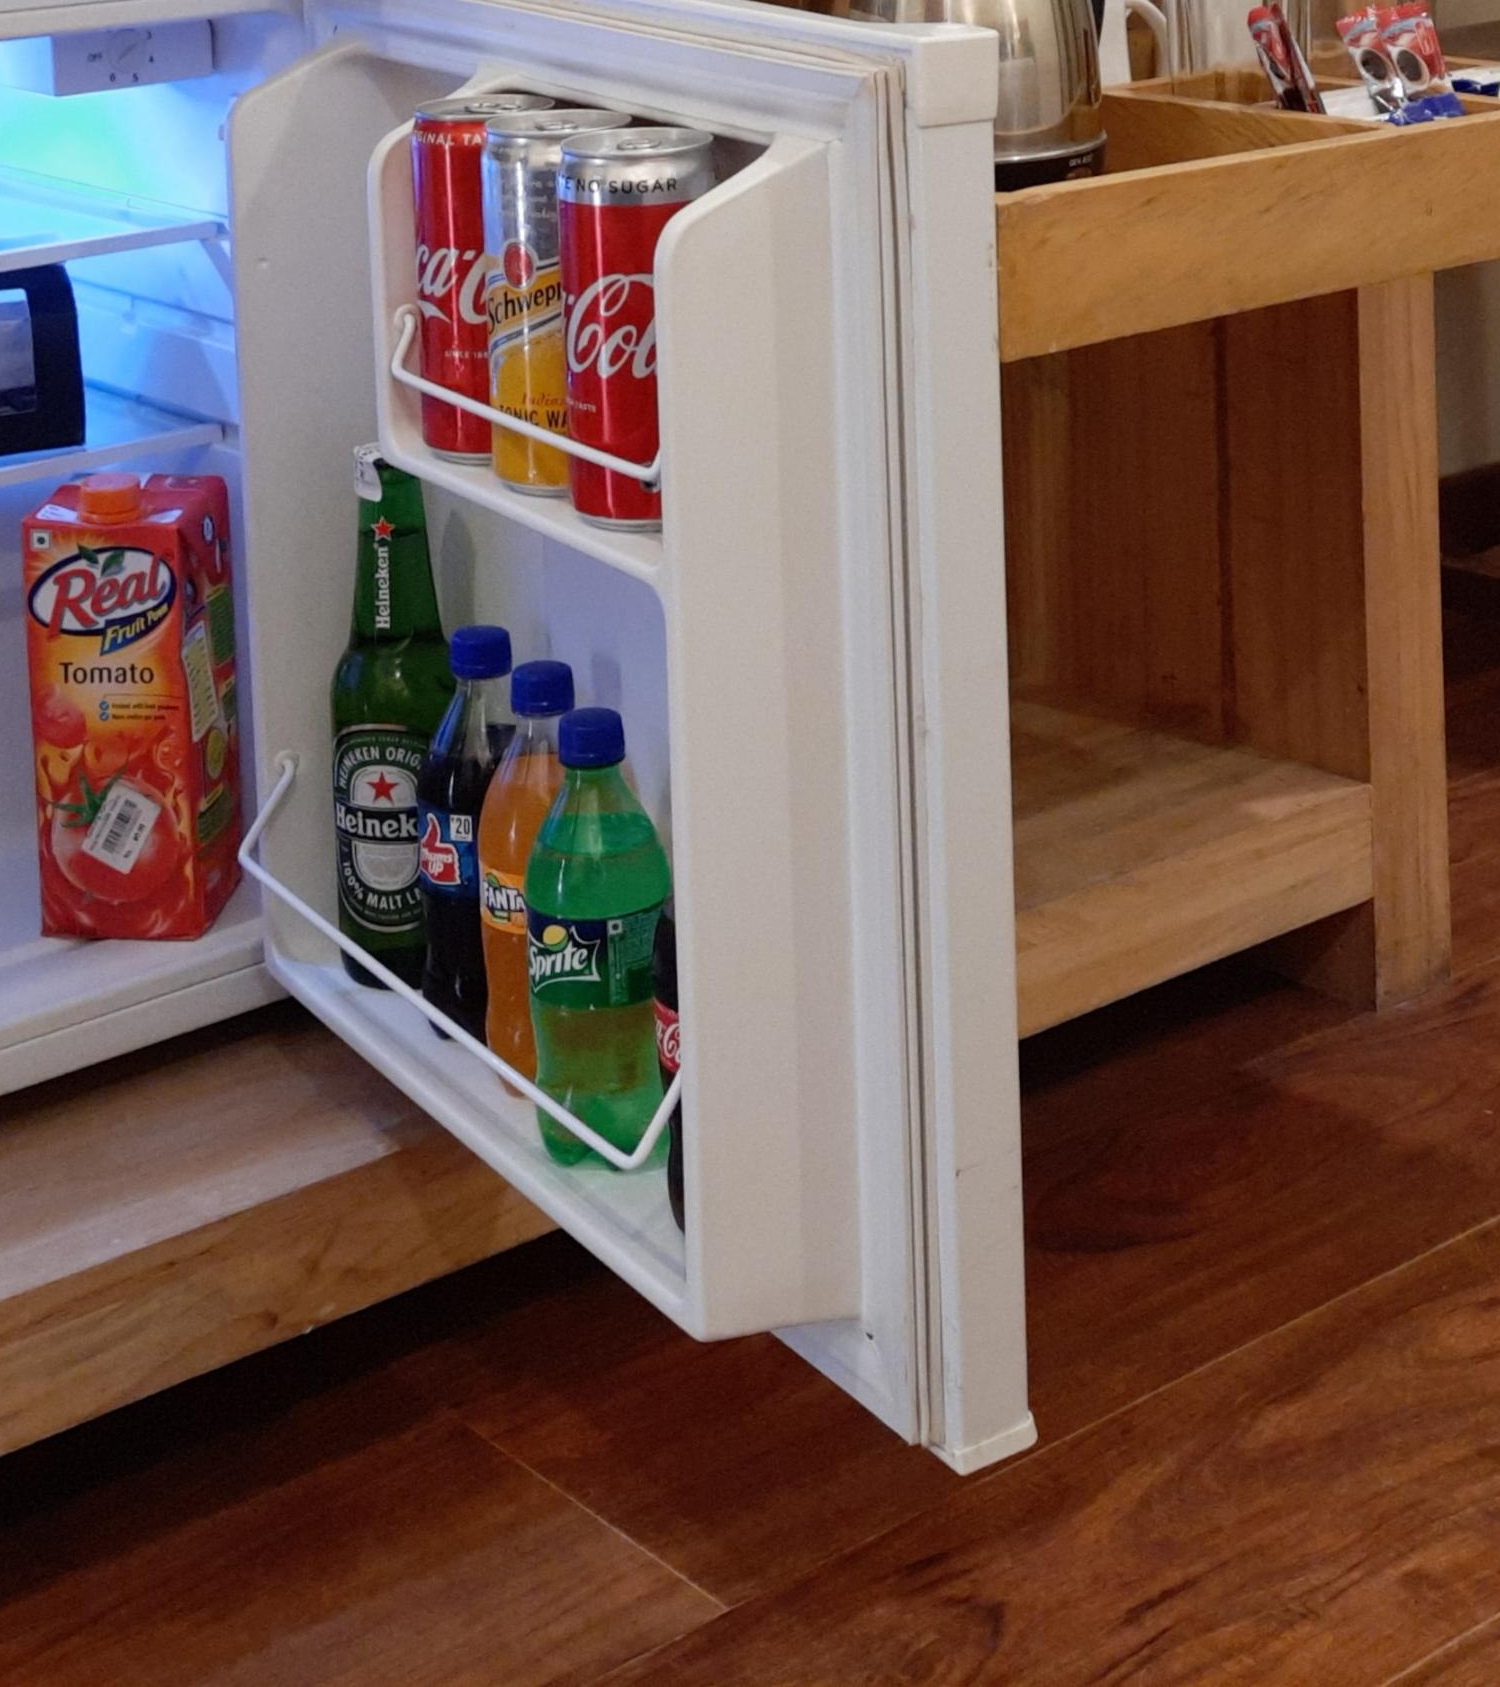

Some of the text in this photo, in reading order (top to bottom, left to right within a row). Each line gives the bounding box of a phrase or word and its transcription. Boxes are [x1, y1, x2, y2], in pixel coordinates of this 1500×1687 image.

[577, 179, 599, 193] NO
[609, 178, 677, 194] SUGAR
[47, 551, 167, 642] Real
[375, 546, 391, 630] Heineken
[103, 617, 146, 652] Fruit
[59, 661, 155, 685] Tomato
[366, 892, 403, 910] MALT
[530, 940, 589, 985] Sprite
